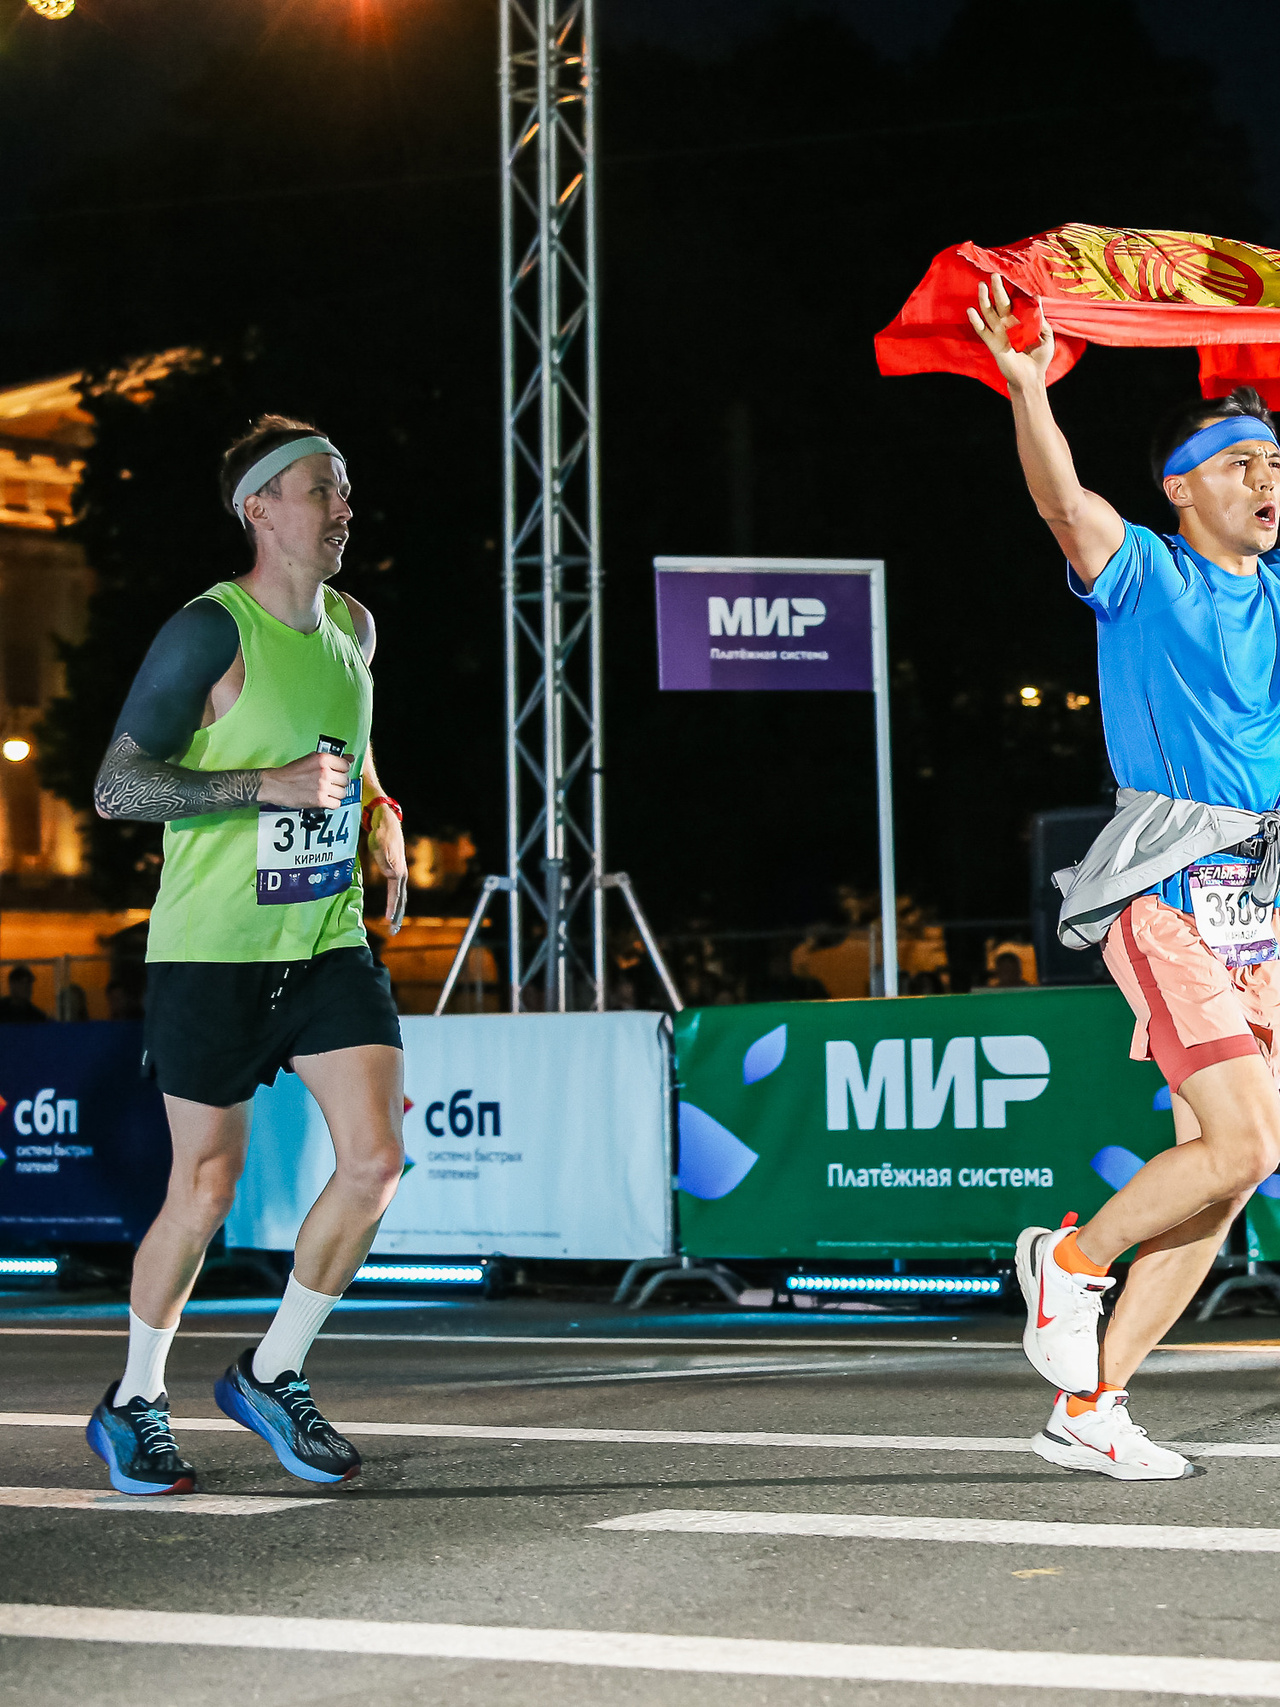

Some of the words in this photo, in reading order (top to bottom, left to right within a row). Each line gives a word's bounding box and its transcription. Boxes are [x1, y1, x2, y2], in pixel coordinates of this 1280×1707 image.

[708, 597, 826, 637] МИР
[709, 647, 777, 661] Платёжная
[779, 650, 829, 661] система
[273, 811, 350, 853] 3144
[294, 852, 334, 865] КИРИЛЛ
[267, 871, 282, 891] D
[826, 1035, 1051, 1130] МИР
[14, 1088, 78, 1136] сбп
[425, 1089, 501, 1137] сбп
[827, 1163, 952, 1188] Платёжная
[958, 1167, 1053, 1188] система
